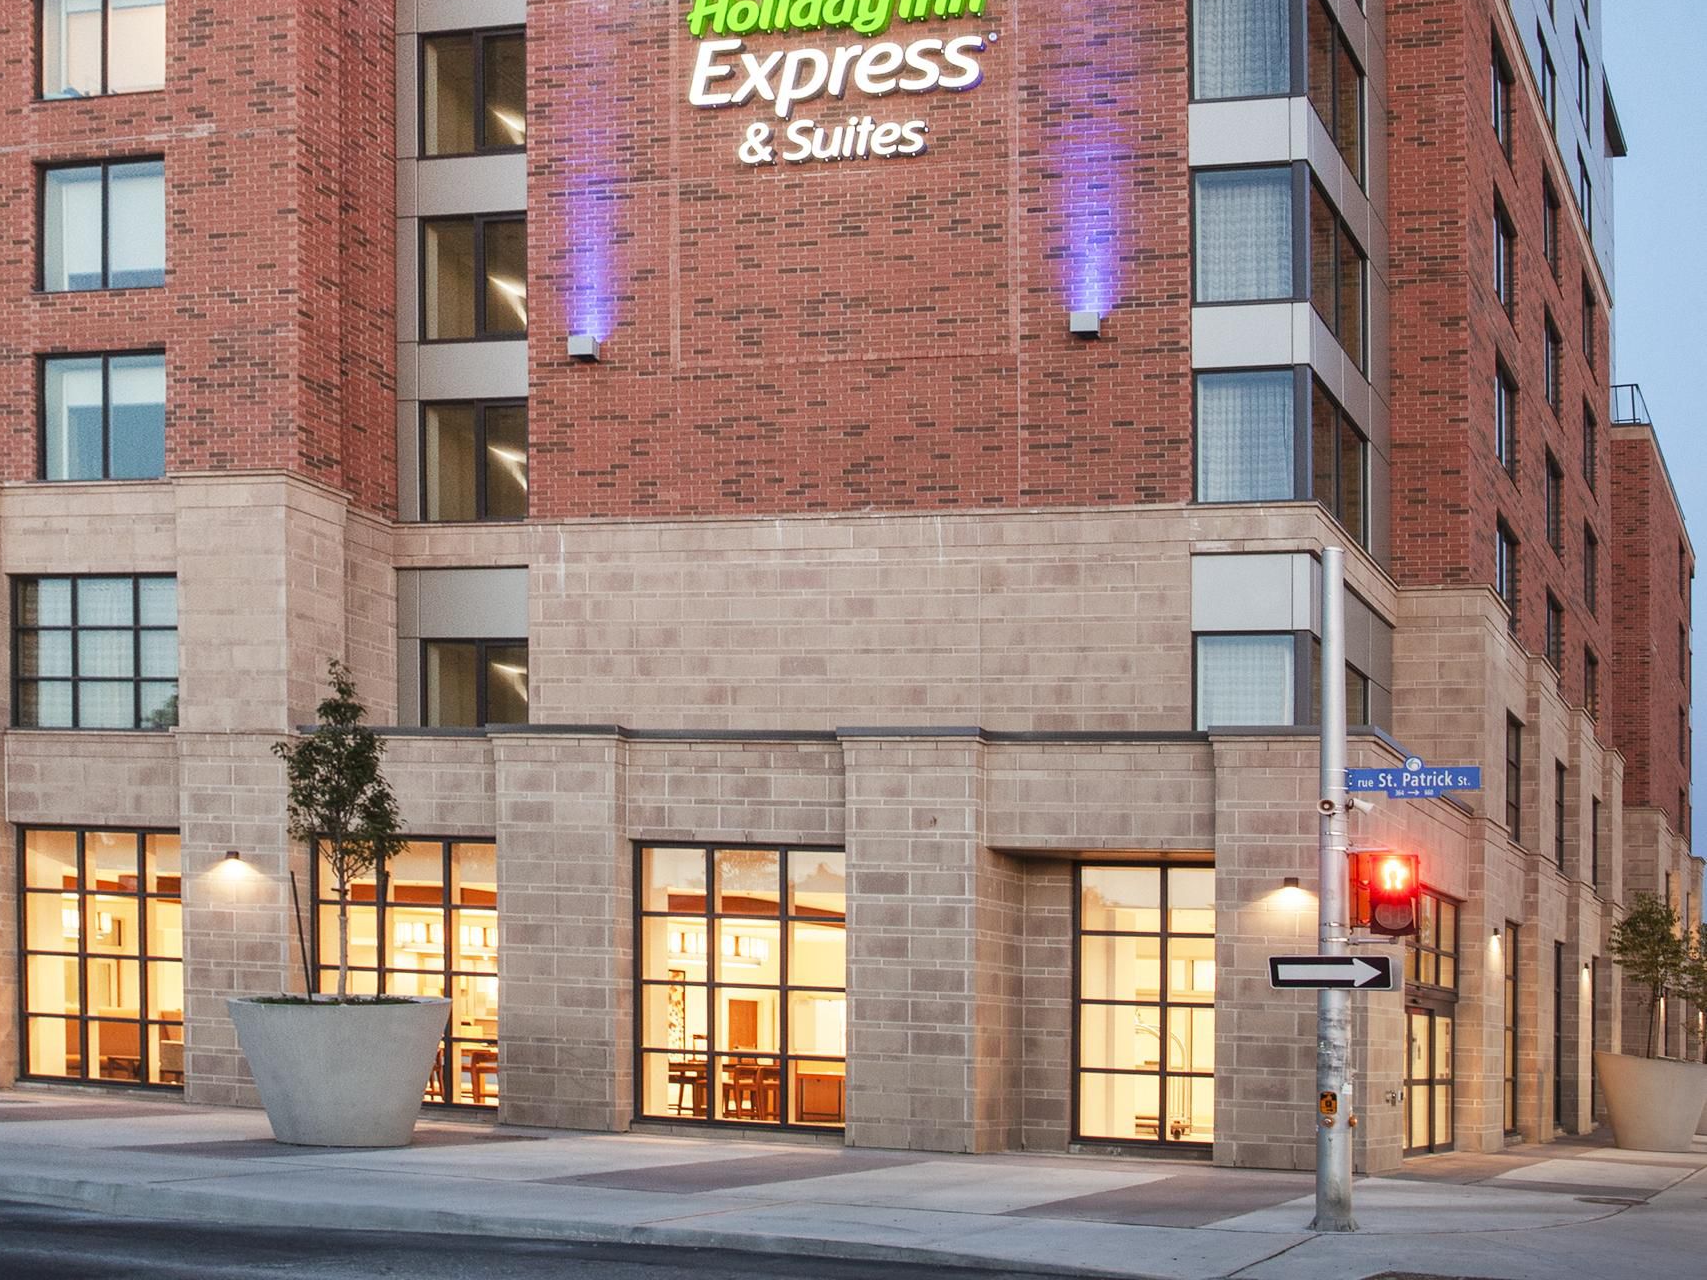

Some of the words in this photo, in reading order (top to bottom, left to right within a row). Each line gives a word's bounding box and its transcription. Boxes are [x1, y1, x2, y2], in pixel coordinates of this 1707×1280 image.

[689, 34, 984, 118] Express
[738, 122, 776, 165] &
[783, 116, 928, 162] Suites
[1357, 779, 1374, 787] rue
[1378, 773, 1397, 787] St.
[1402, 770, 1453, 786] Patrick
[1457, 776, 1471, 786] St.
